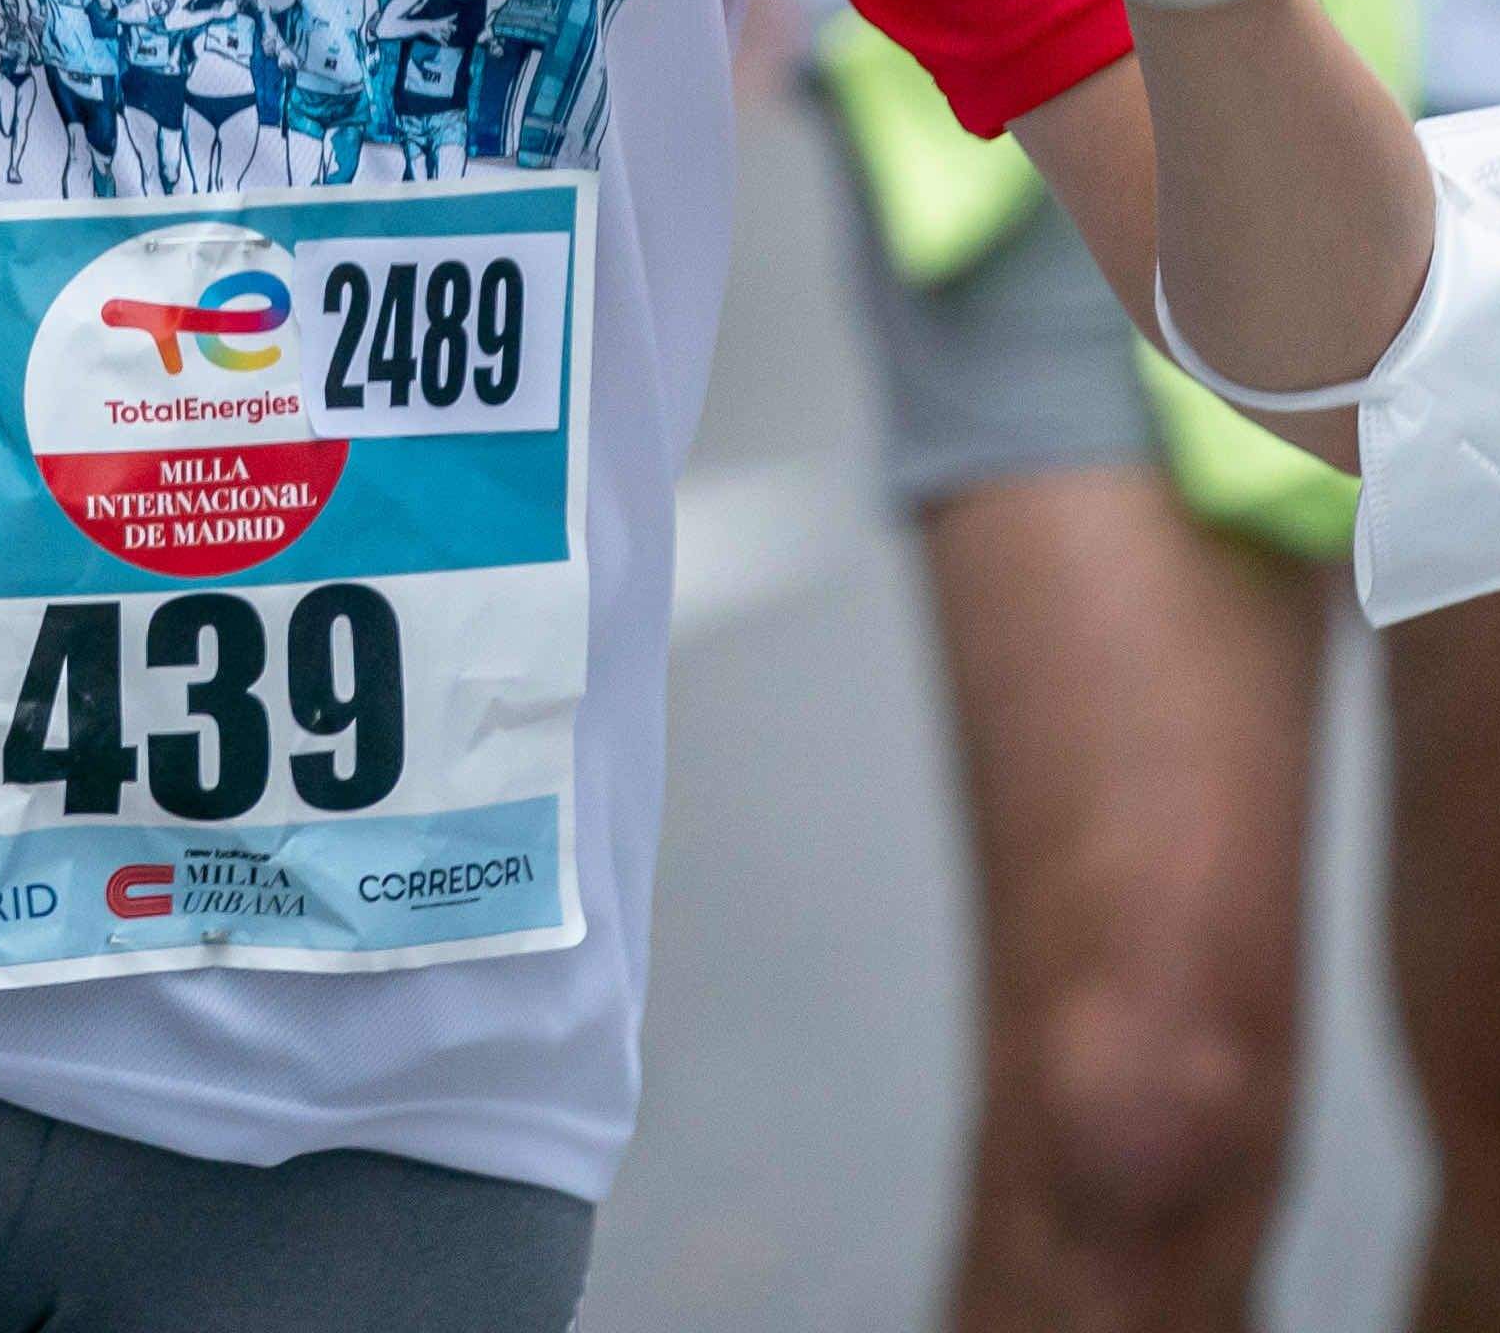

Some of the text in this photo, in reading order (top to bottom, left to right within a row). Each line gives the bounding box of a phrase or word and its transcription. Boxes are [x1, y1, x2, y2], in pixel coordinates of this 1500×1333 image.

[323, 258, 524, 409] 2489
[105, 391, 299, 425] TotalEnergies
[159, 459, 249, 486] MILLA
[124, 516, 285, 550] DE MADRID
[3, 583, 406, 820] 439
[187, 863, 291, 887] MILLA
[183, 890, 305, 916] URBANA
